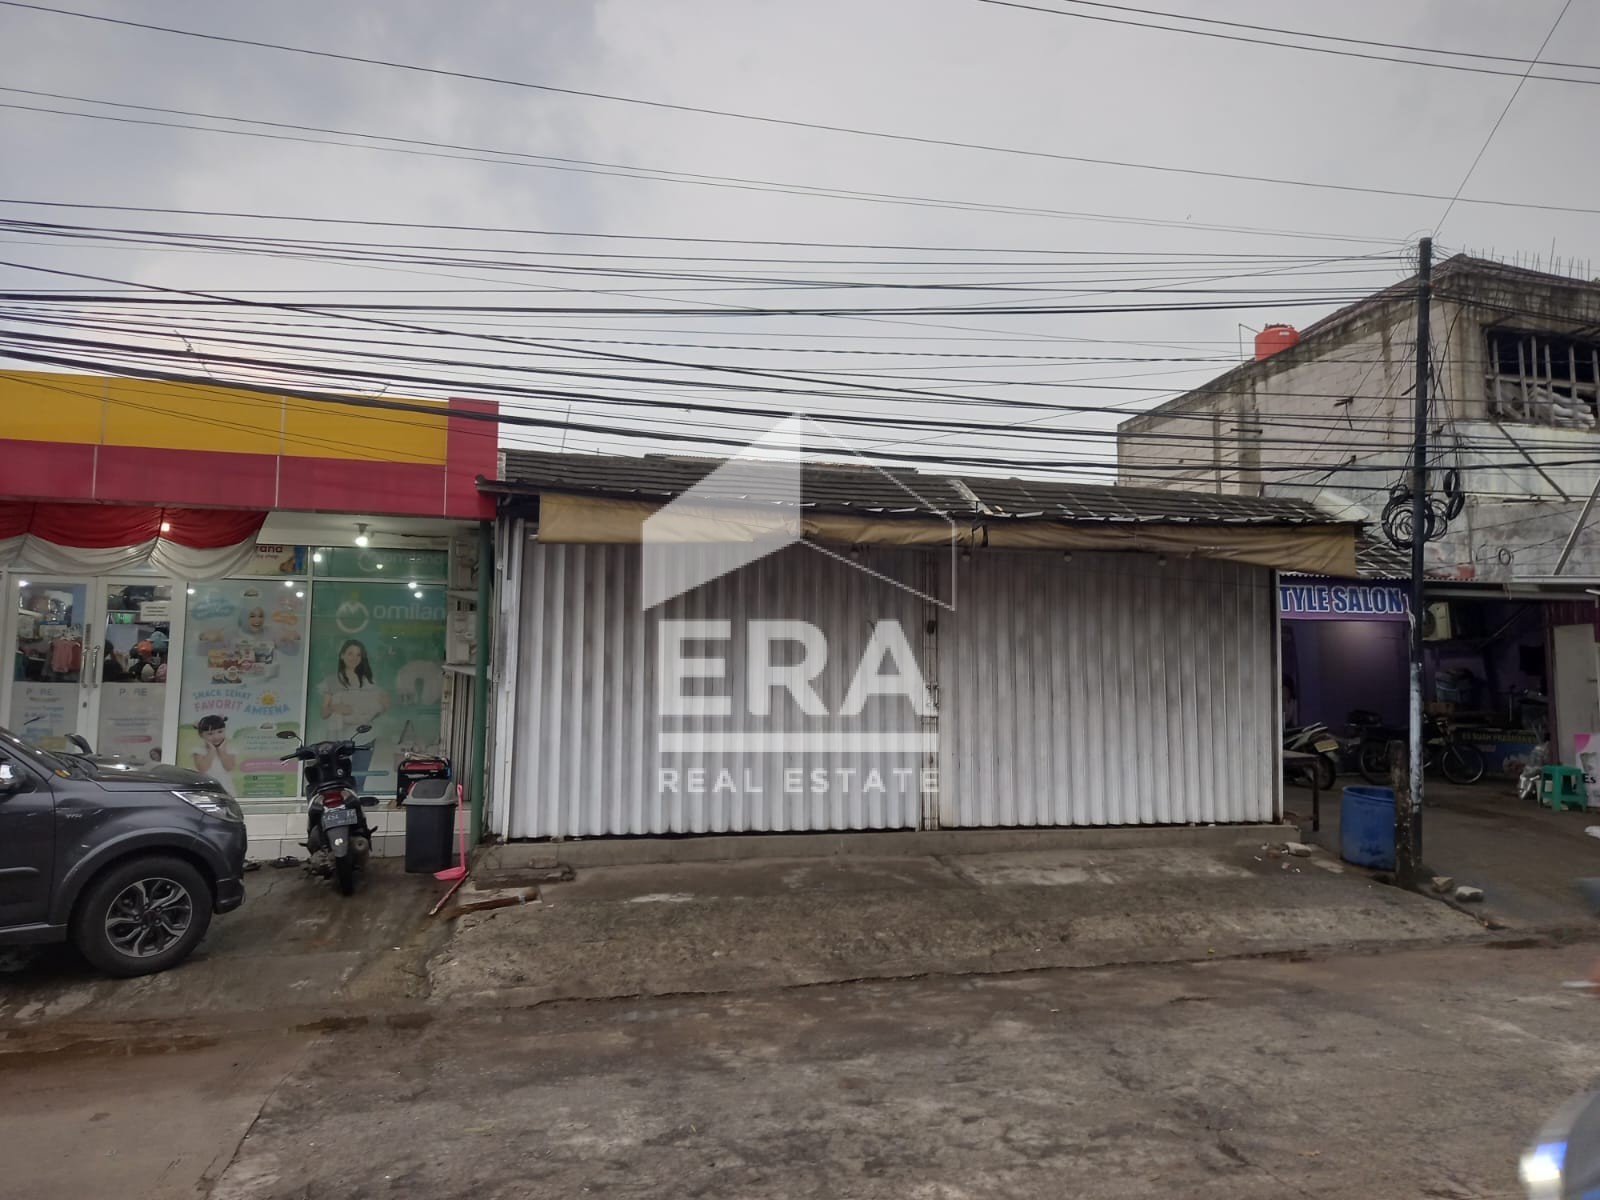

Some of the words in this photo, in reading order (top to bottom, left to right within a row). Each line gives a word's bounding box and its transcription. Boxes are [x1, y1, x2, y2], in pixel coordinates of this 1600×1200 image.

[1280, 585, 1330, 612] TYLE
[1331, 586, 1404, 614] SALON
[194, 699, 244, 712] FAVORIT
